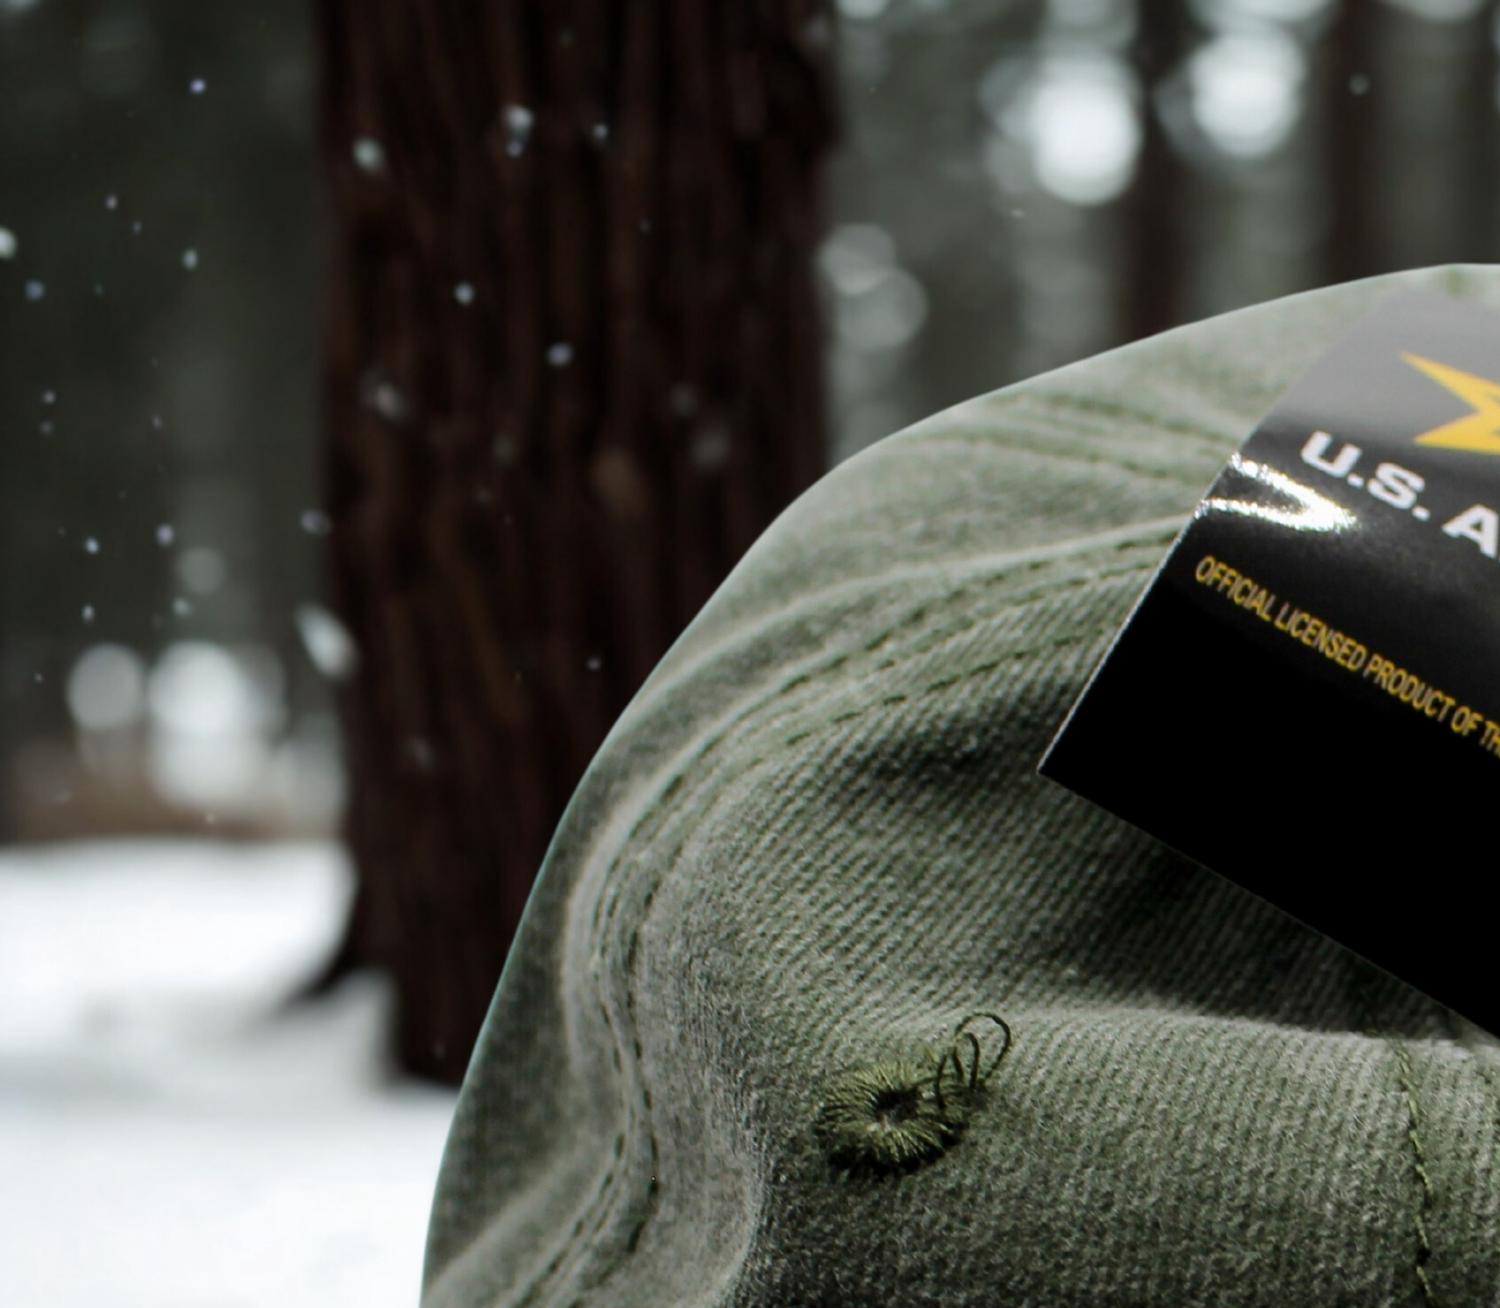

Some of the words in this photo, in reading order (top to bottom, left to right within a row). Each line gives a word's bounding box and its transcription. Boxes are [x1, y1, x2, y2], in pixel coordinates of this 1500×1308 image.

[1301, 431, 1430, 520] U.S.
[1195, 555, 1276, 622] OFFICIAL
[1274, 602, 1368, 671] LICENSED
[1363, 654, 1455, 722] PRODUCT
[1451, 706, 1484, 736] OF
